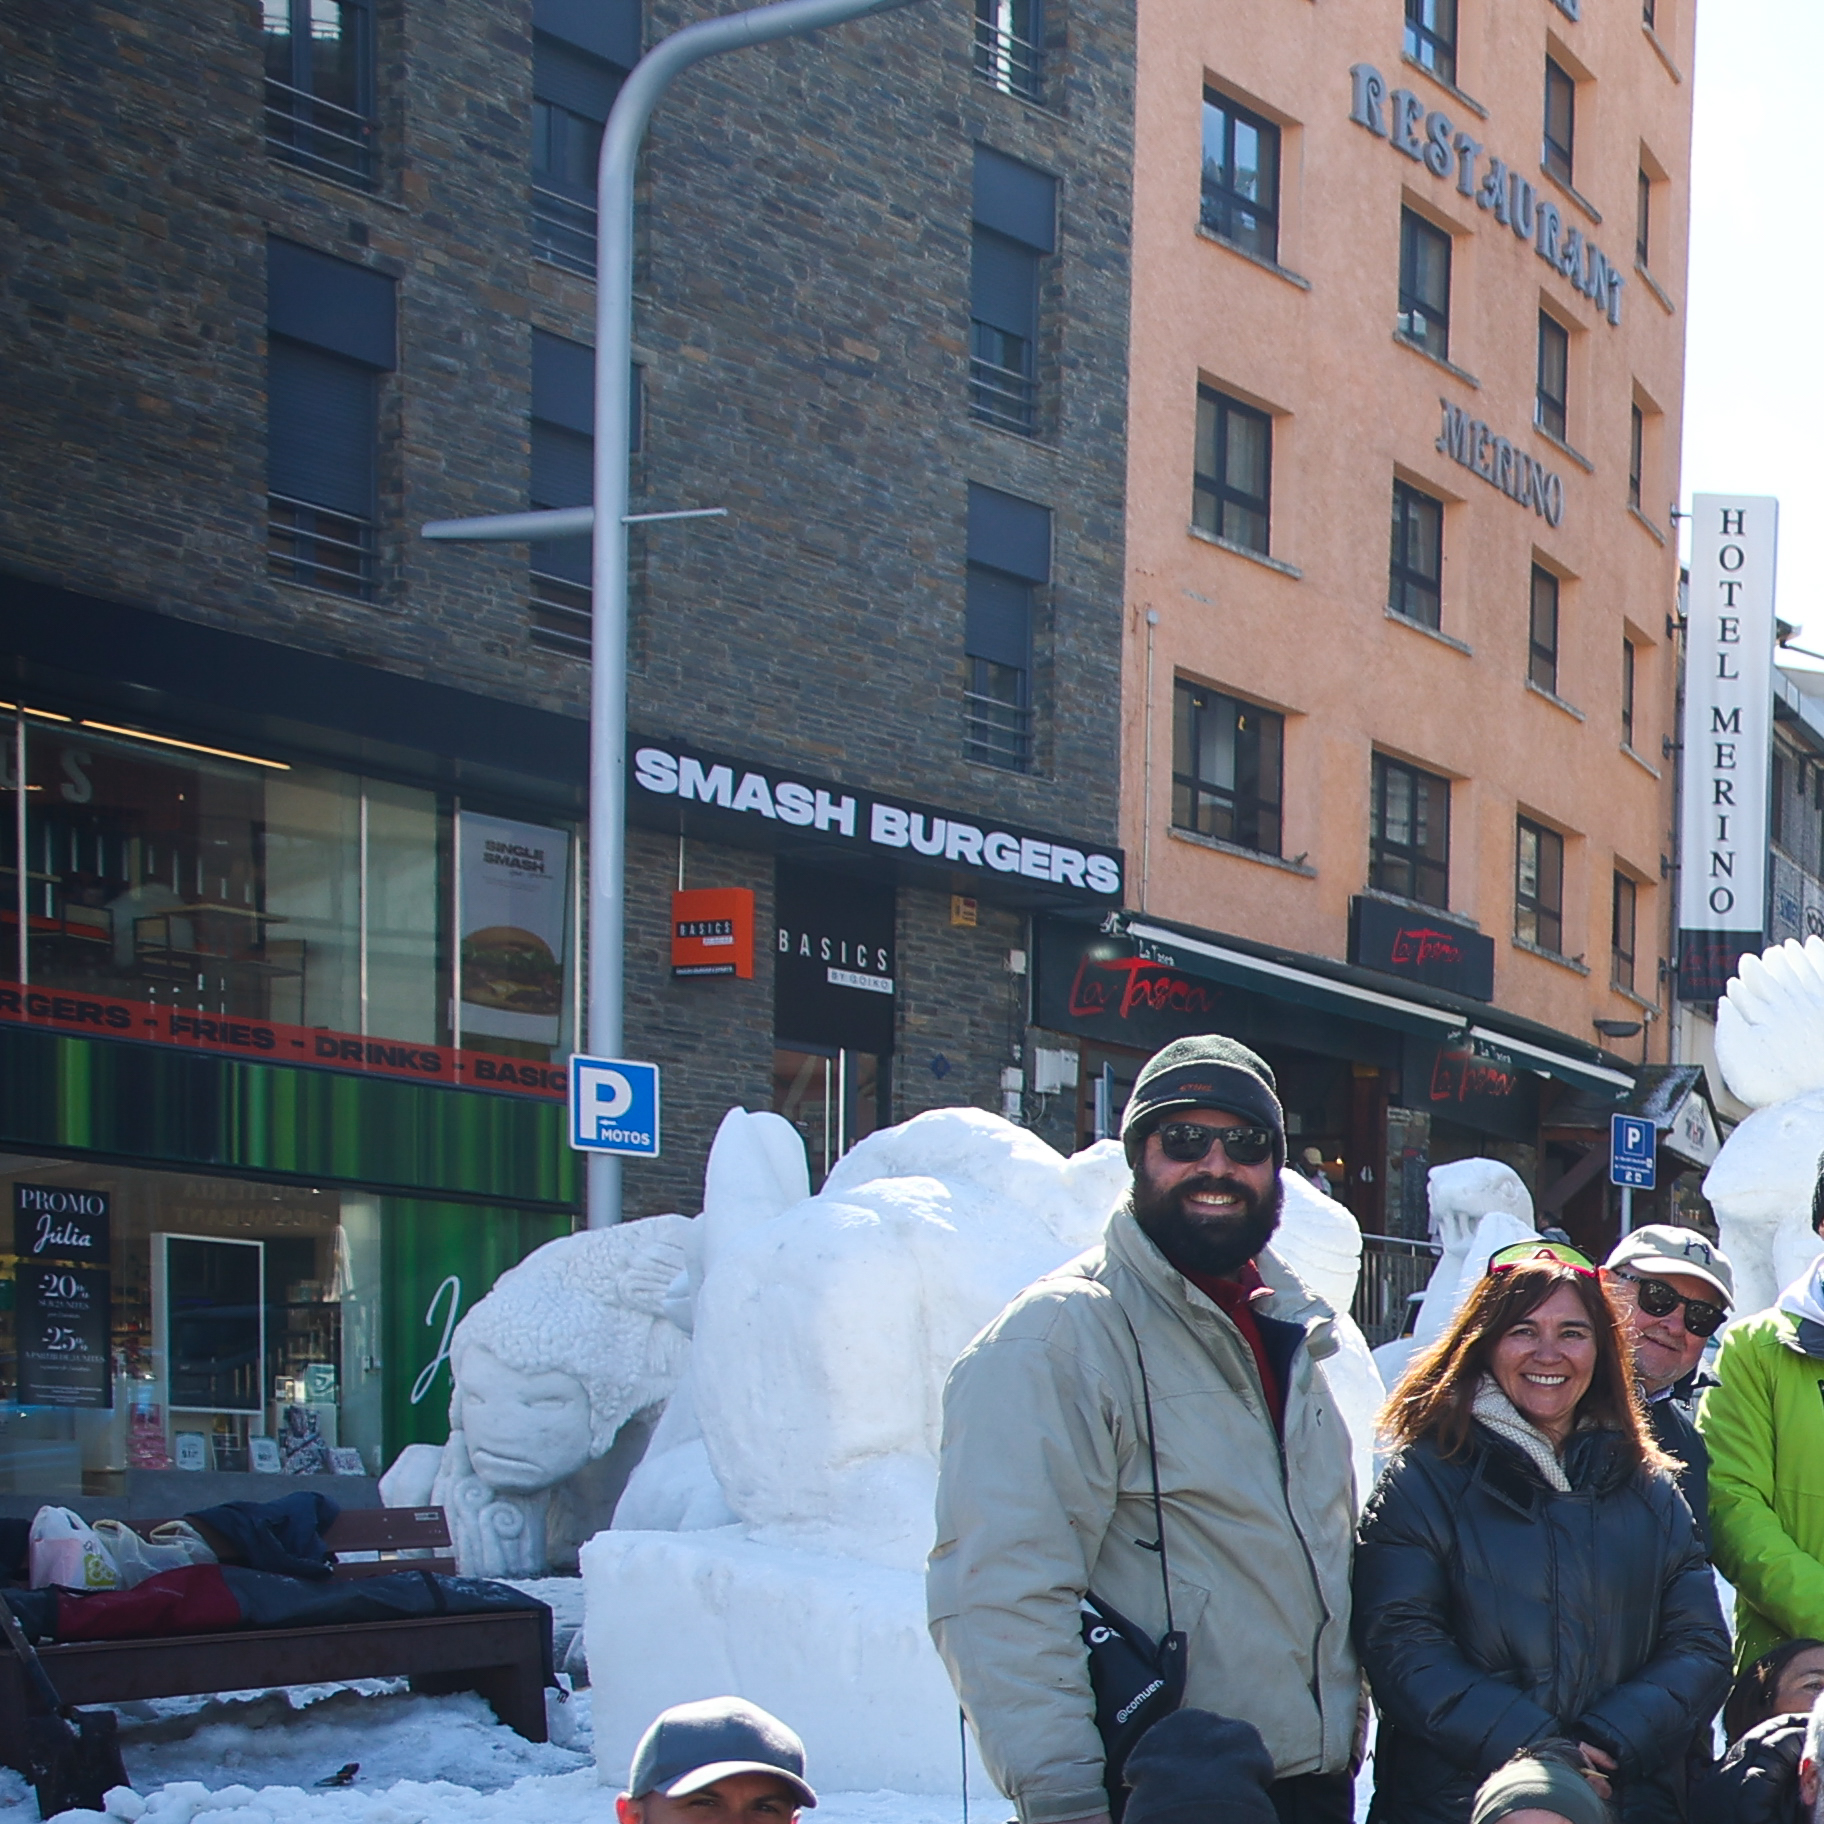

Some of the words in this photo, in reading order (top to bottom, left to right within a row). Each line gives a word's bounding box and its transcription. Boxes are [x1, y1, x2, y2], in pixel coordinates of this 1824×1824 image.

[1349, 62, 1626, 327] RESTAURANT
[1435, 397, 1566, 529] MERINO
[1716, 508, 1748, 680] HOTEL
[634, 748, 857, 837] SMASH
[871, 802, 1121, 895] BURGERS
[1708, 707, 1743, 915] MERINO
[483, 852, 545, 874] SMASH
[484, 839, 545, 861] SINGLE
[680, 921, 731, 936] BASICS
[778, 928, 888, 972] BASICS
[831, 971, 845, 982] BY
[849, 974, 890, 989] GOIKO
[169, 1014, 275, 1050] FRIES
[314, 1034, 442, 1073] DRINKS
[578, 1065, 634, 1141] P
[601, 1128, 651, 1146] MOTOS
[1628, 1127, 1641, 1149] P
[20, 1188, 105, 1216] PROMO
[33, 1213, 93, 1254] Júlia
